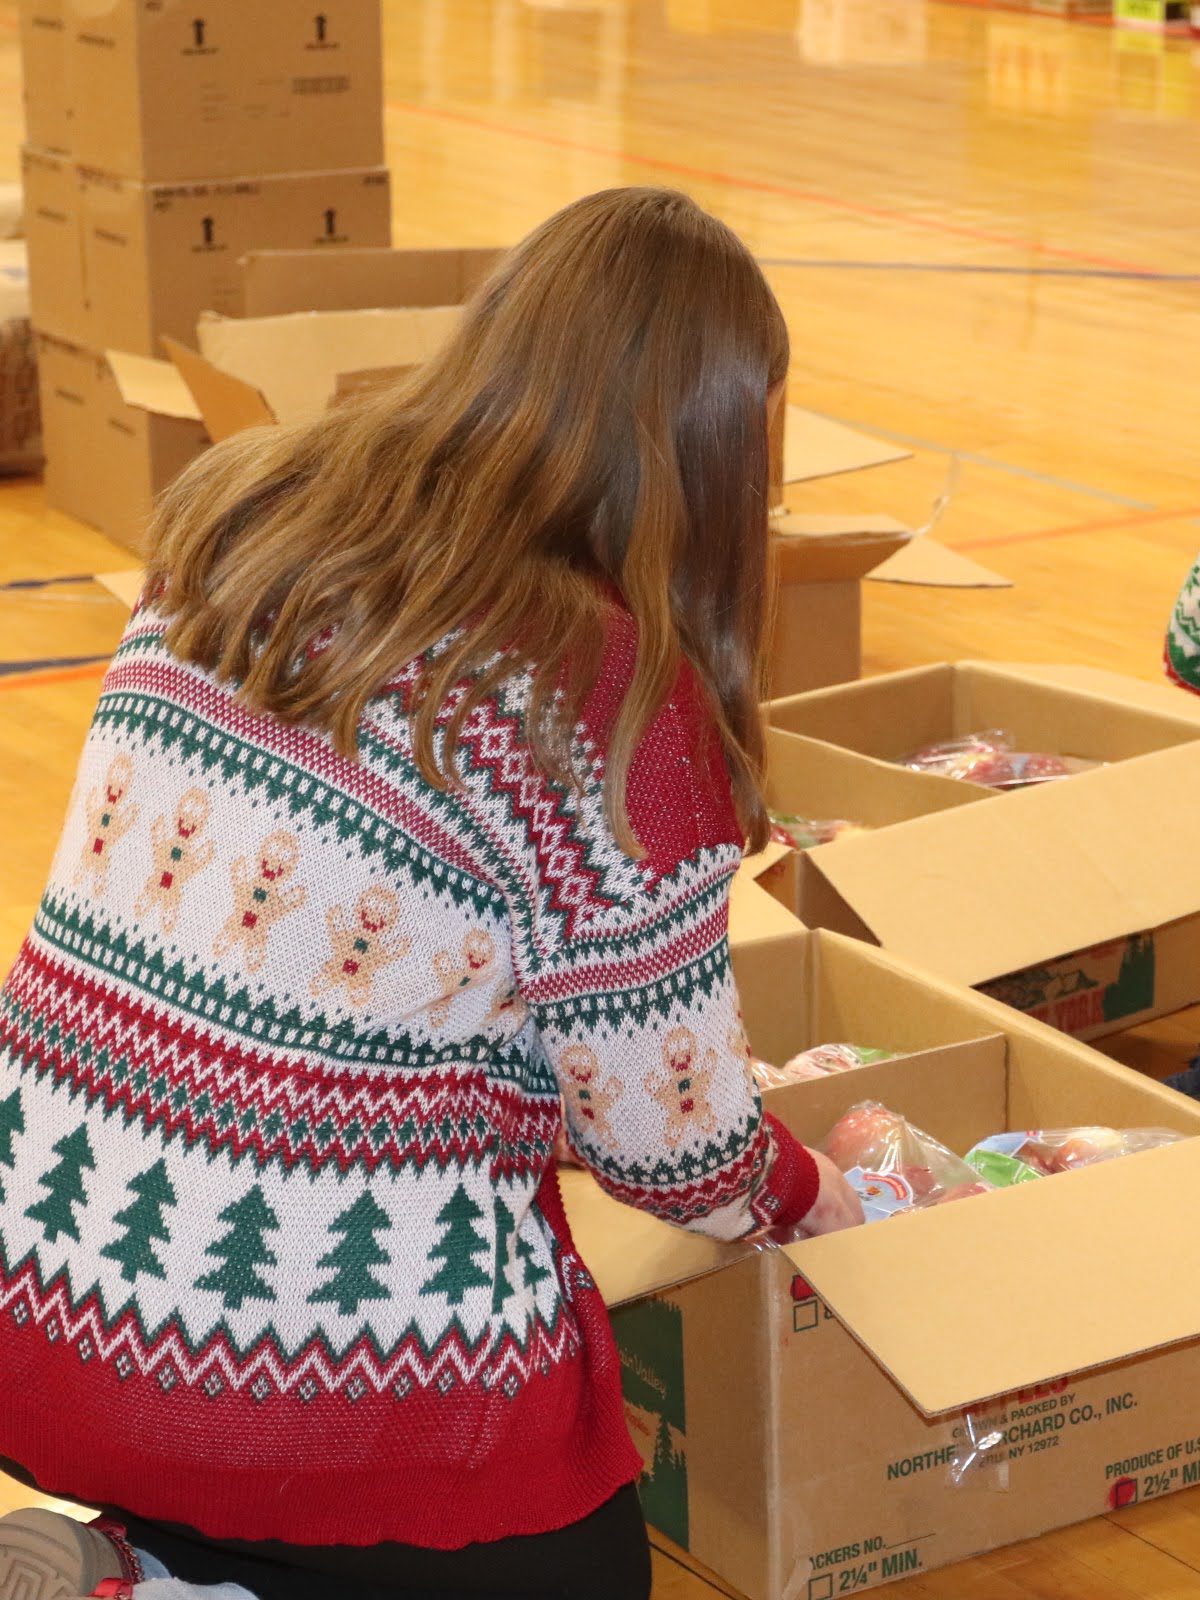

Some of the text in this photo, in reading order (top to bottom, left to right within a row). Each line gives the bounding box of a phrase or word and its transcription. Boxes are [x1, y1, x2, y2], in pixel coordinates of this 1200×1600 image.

[1001, 1413, 1008, 1424] &
[1011, 1399, 1057, 1422] PACKED
[1060, 1393, 1076, 1408] BY
[1106, 1392, 1138, 1415] INC.
[1008, 1447, 1025, 1460] NY
[1029, 1436, 1060, 1454] 12972
[1105, 1449, 1163, 1480] PRODUCE
[1167, 1443, 1183, 1460] OF
[864, 1535, 887, 1553] NO.
[881, 1548, 923, 1578] MIN.
